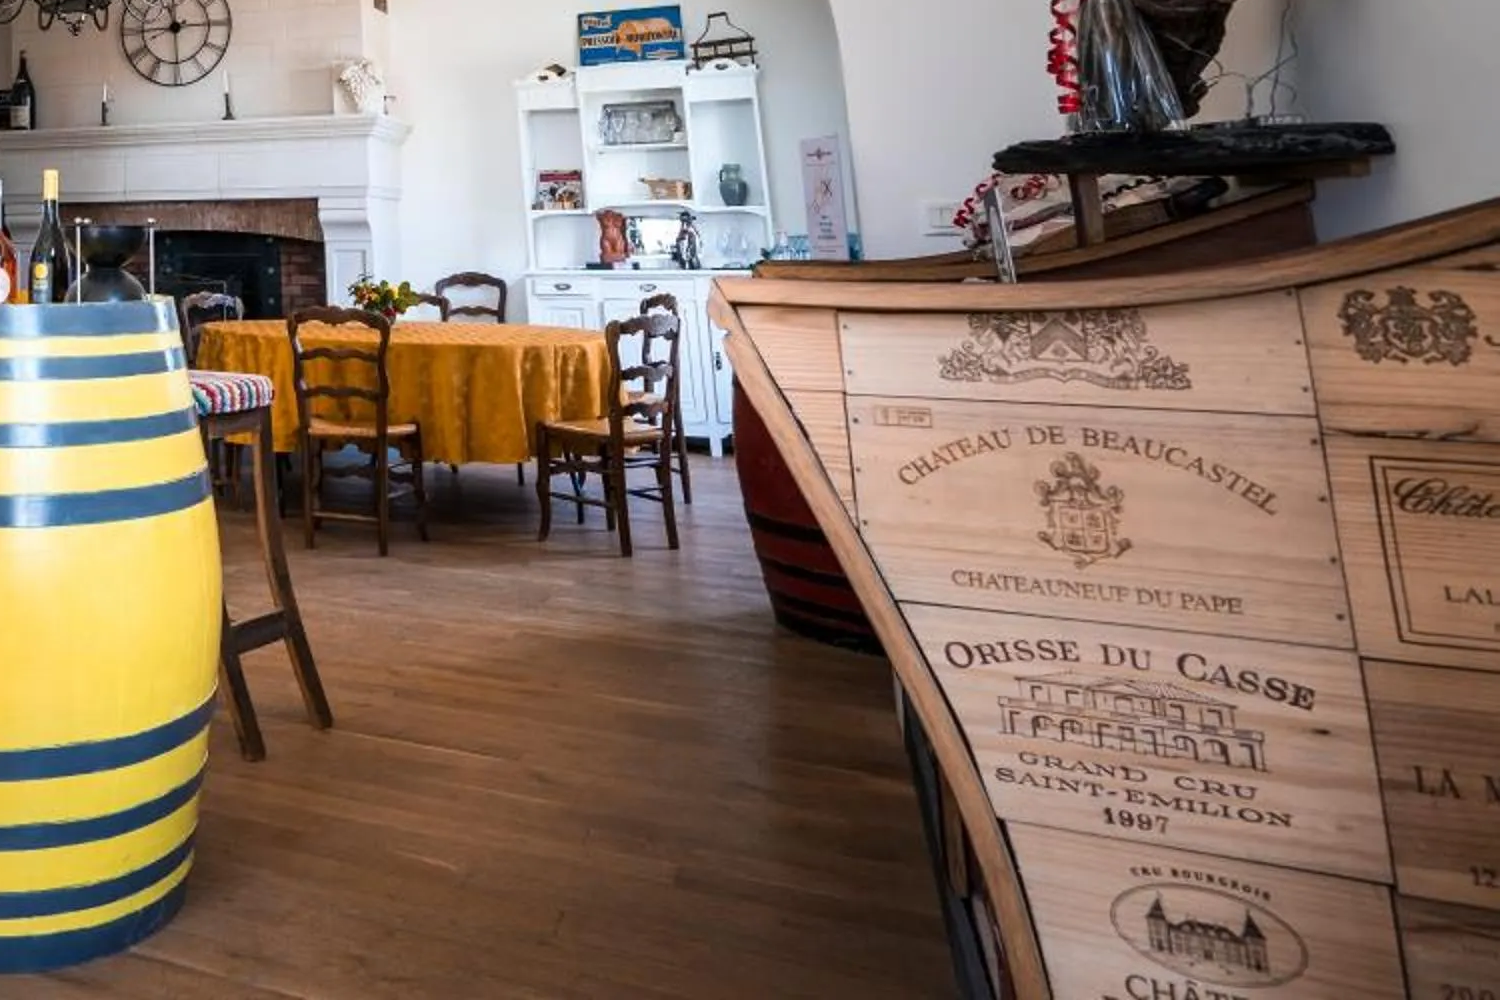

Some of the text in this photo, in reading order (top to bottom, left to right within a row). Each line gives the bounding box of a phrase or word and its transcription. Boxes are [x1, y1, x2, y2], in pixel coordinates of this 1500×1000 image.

[897, 425, 1279, 516] CHATEAU DE BEAUCASTEL
[950, 568, 1244, 615] CHATEAUNEUF DU PAPE
[944, 639, 1317, 712] ORISSE DU CASSE
[994, 767, 1293, 828] SAINT-EMILION
[1018, 750, 1258, 801] GRAND CRU
[1102, 806, 1171, 835] 1997
